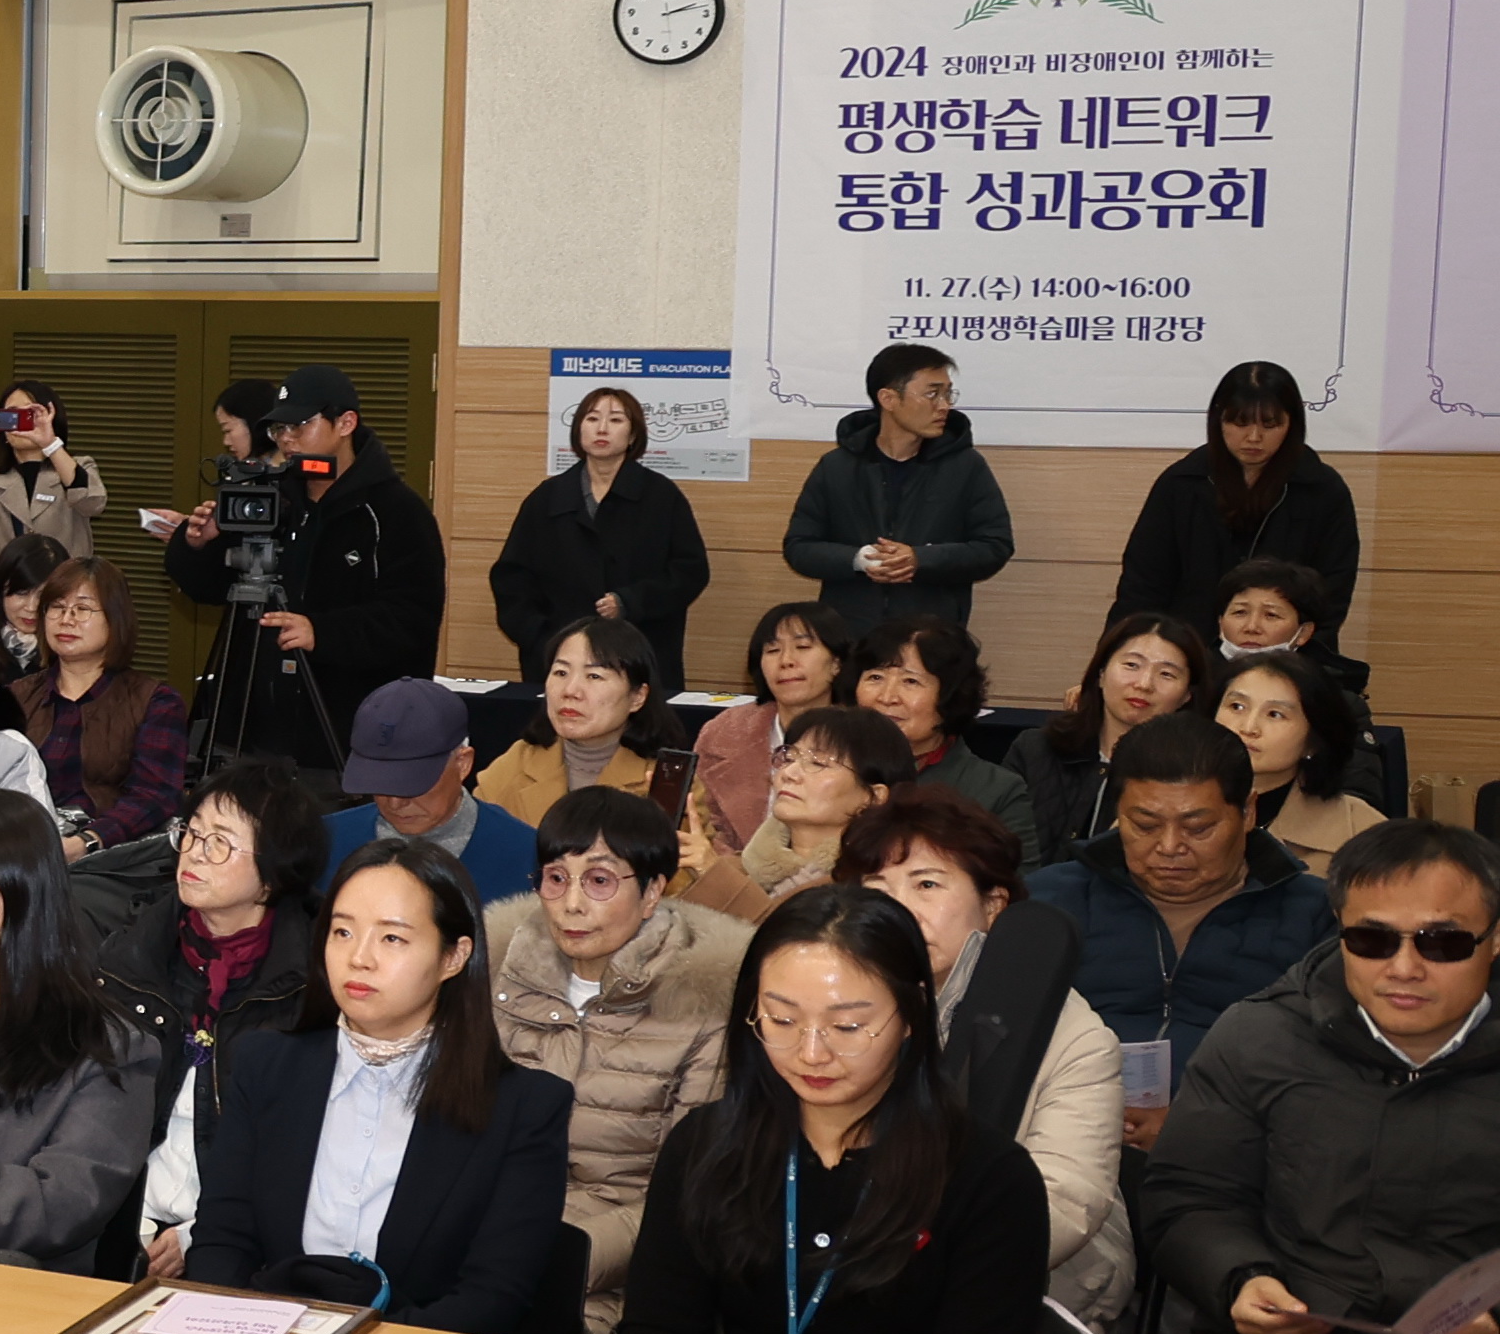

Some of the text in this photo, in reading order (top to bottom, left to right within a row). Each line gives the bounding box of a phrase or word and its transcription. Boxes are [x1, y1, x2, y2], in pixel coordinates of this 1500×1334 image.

[628, 8, 636, 17] 9
[702, 10, 710, 18] 3
[632, 27, 639, 35] 8
[695, 27, 703, 35] 4
[645, 39, 653, 47] 7
[681, 41, 688, 49] 5
[661, 45, 669, 53] 6
[839, 45, 1275, 79] 2024 장애인과 비장애인이 함께하는
[838, 94, 1273, 154] 평생학습 네트워크
[835, 168, 1267, 232] 통합 성과공유회
[904, 275, 1191, 301] 11. 27.(수) 14:00~16:00
[887, 315, 1207, 343] 군포시평생학습마을 대강당
[562, 357, 732, 374] 피난안내도 EVACUATION PLA
